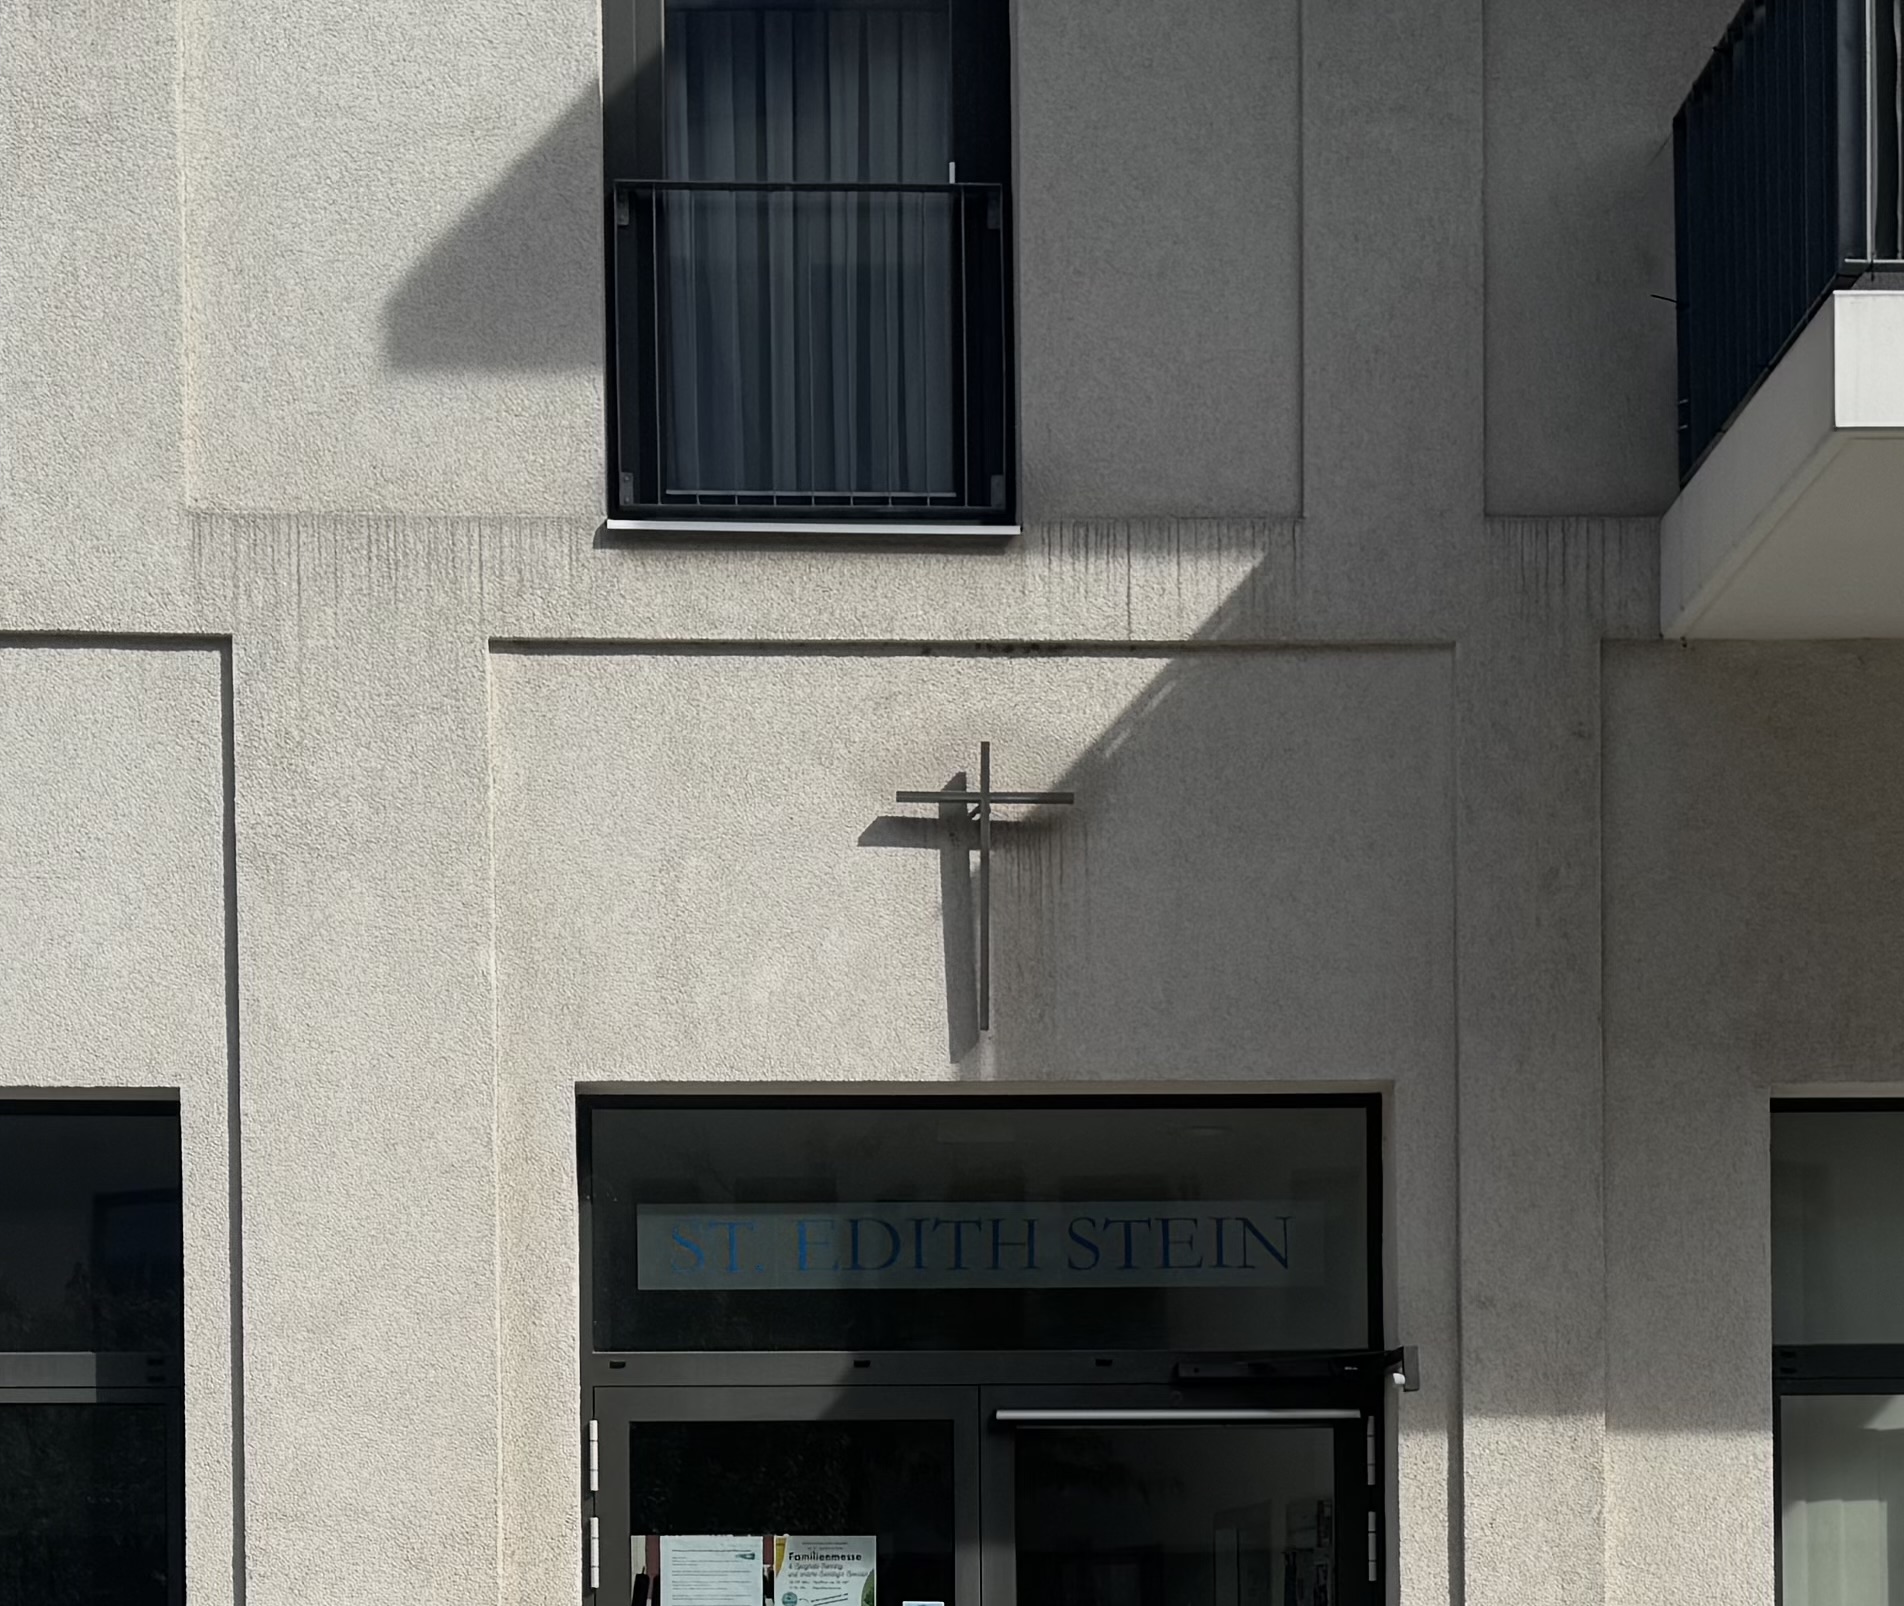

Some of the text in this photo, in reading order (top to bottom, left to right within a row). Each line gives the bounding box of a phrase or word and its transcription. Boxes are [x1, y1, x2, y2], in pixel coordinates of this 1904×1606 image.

[670, 1215, 1293, 1276] ST. EDITH STEIN
[788, 1550, 863, 1562] Familienmesse
